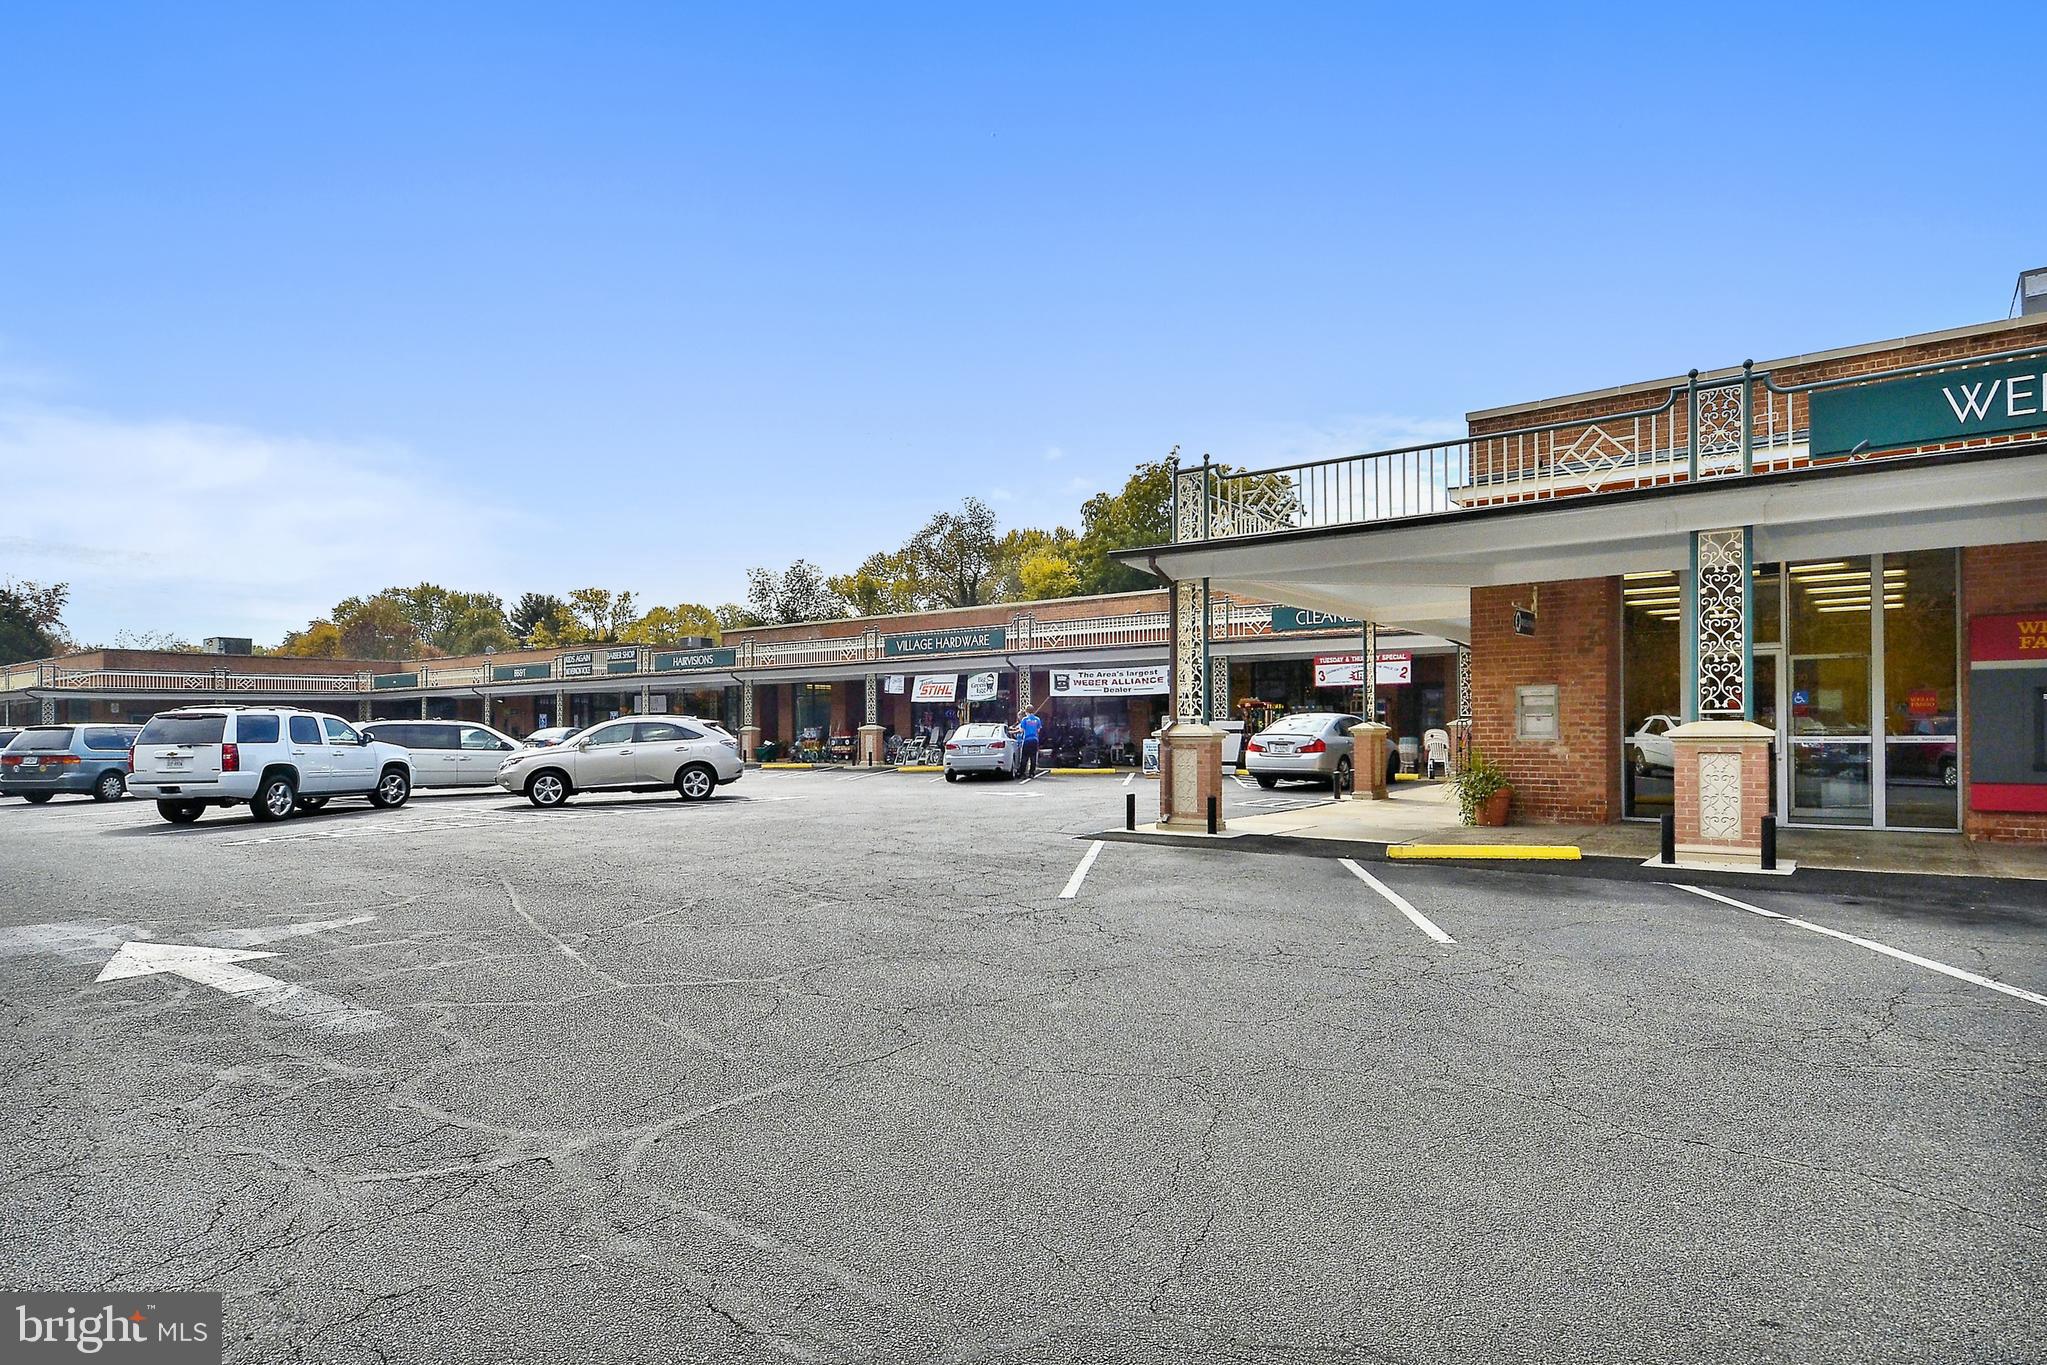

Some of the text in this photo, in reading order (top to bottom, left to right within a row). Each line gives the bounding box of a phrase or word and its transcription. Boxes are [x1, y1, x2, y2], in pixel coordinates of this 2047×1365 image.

[1942, 373, 2047, 424] WE
[896, 634, 990, 651] VILLAGE HARDWARE
[623, 650, 635, 659] SHOP
[673, 655, 713, 666] HAIRVISIONS
[1126, 669, 1158, 677] largest
[1318, 670, 1326, 681] 3
[1399, 667, 1408, 679] 2
[1111, 677, 1164, 685] ALLIANCE
[920, 684, 952, 695] STIHL
